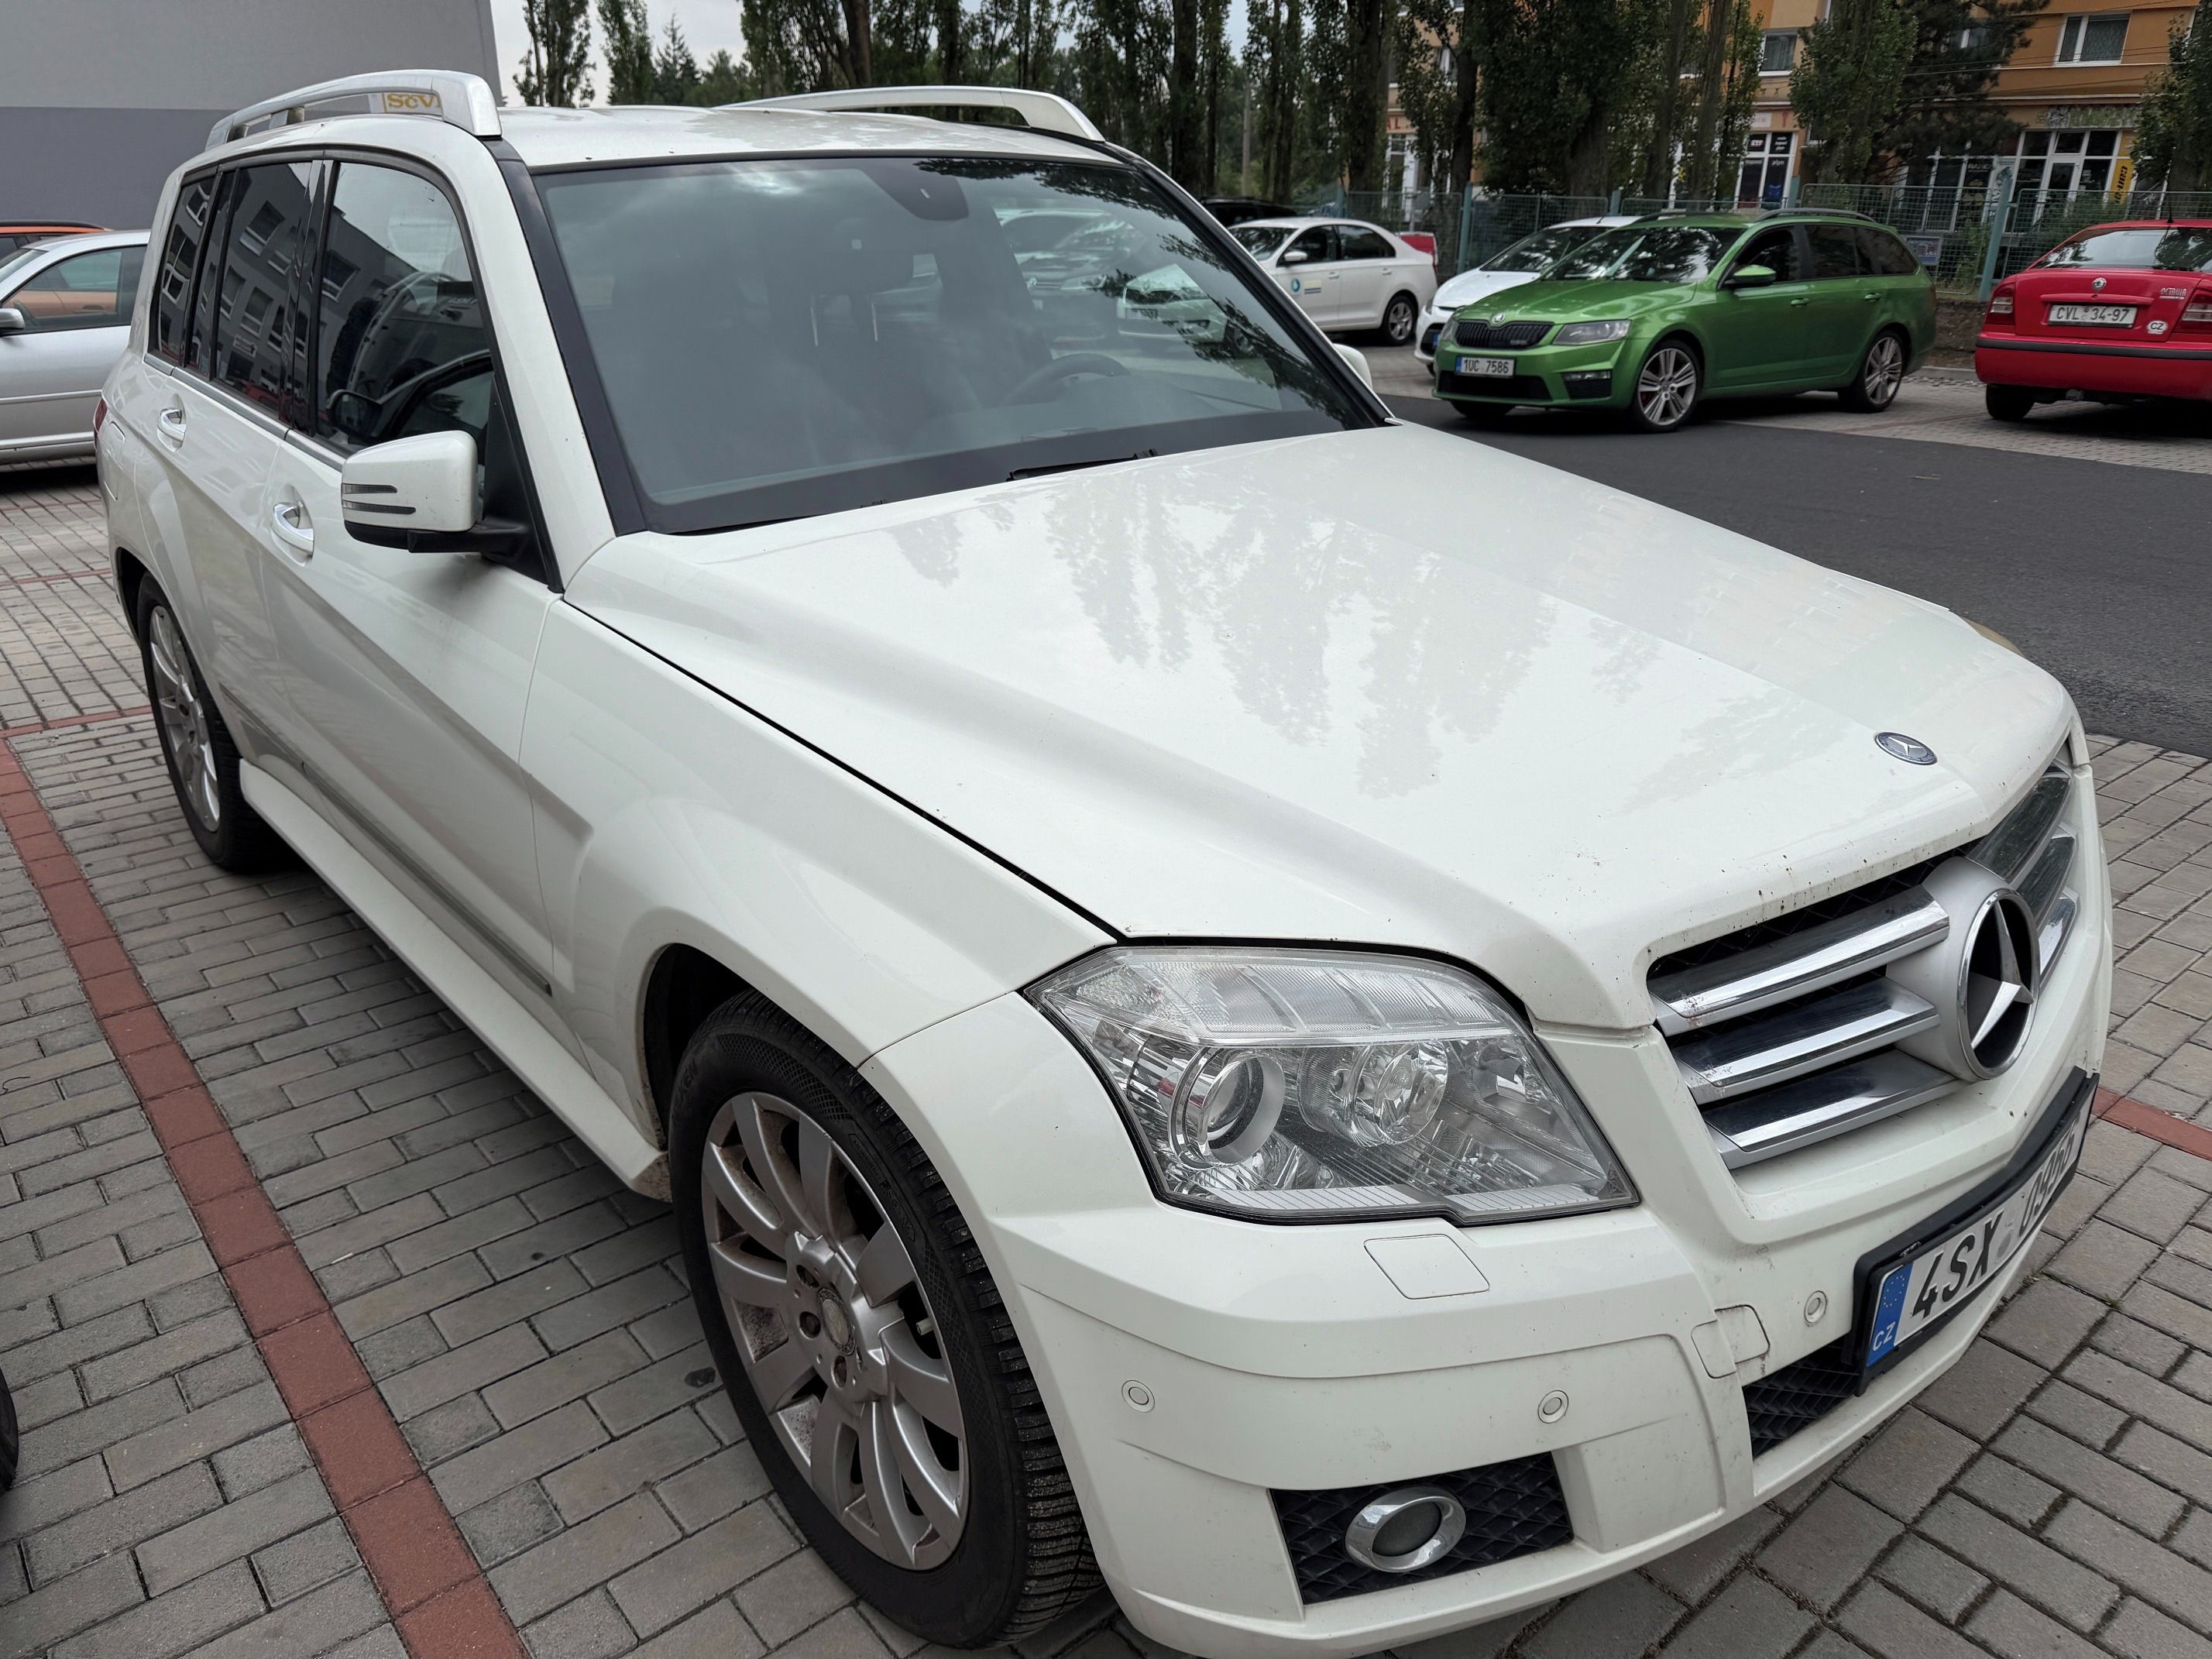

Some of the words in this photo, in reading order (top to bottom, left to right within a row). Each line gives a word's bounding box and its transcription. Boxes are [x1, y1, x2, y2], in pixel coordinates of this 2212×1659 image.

[2056, 306, 2079, 321] CVL
[2090, 307, 2130, 322] 34-97
[2150, 321, 2164, 331] CZ
[1464, 359, 1479, 372] 1UC
[1486, 360, 1509, 374] 7586
[1911, 1208, 2004, 1319] 4SX
[1872, 1321, 1896, 1352] CZ
